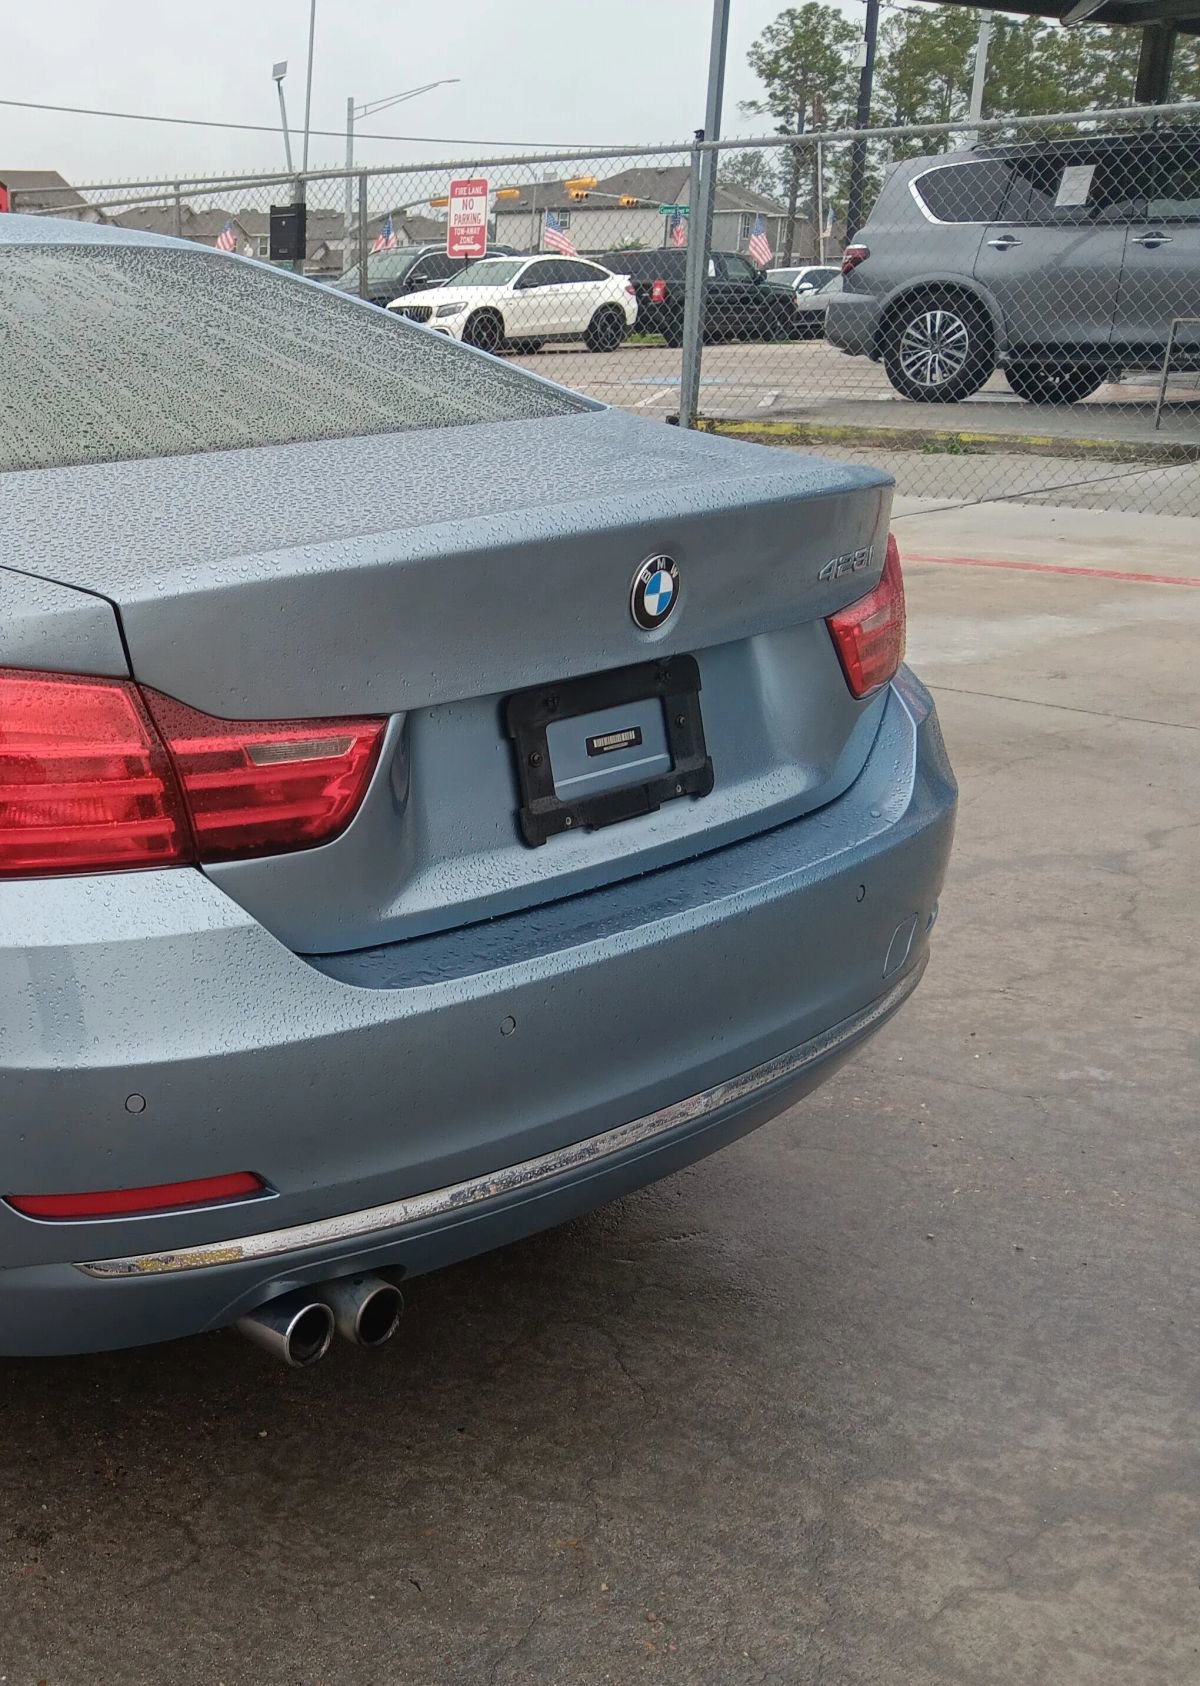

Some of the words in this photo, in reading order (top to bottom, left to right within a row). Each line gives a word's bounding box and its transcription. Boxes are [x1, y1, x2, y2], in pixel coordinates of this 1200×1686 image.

[455, 187, 467, 196] FIRE
[468, 185, 483, 195] LANE
[462, 198, 475, 211] NO
[454, 212, 481, 225] PARKING
[460, 235, 474, 244] ZONE
[640, 557, 679, 584] BMW
